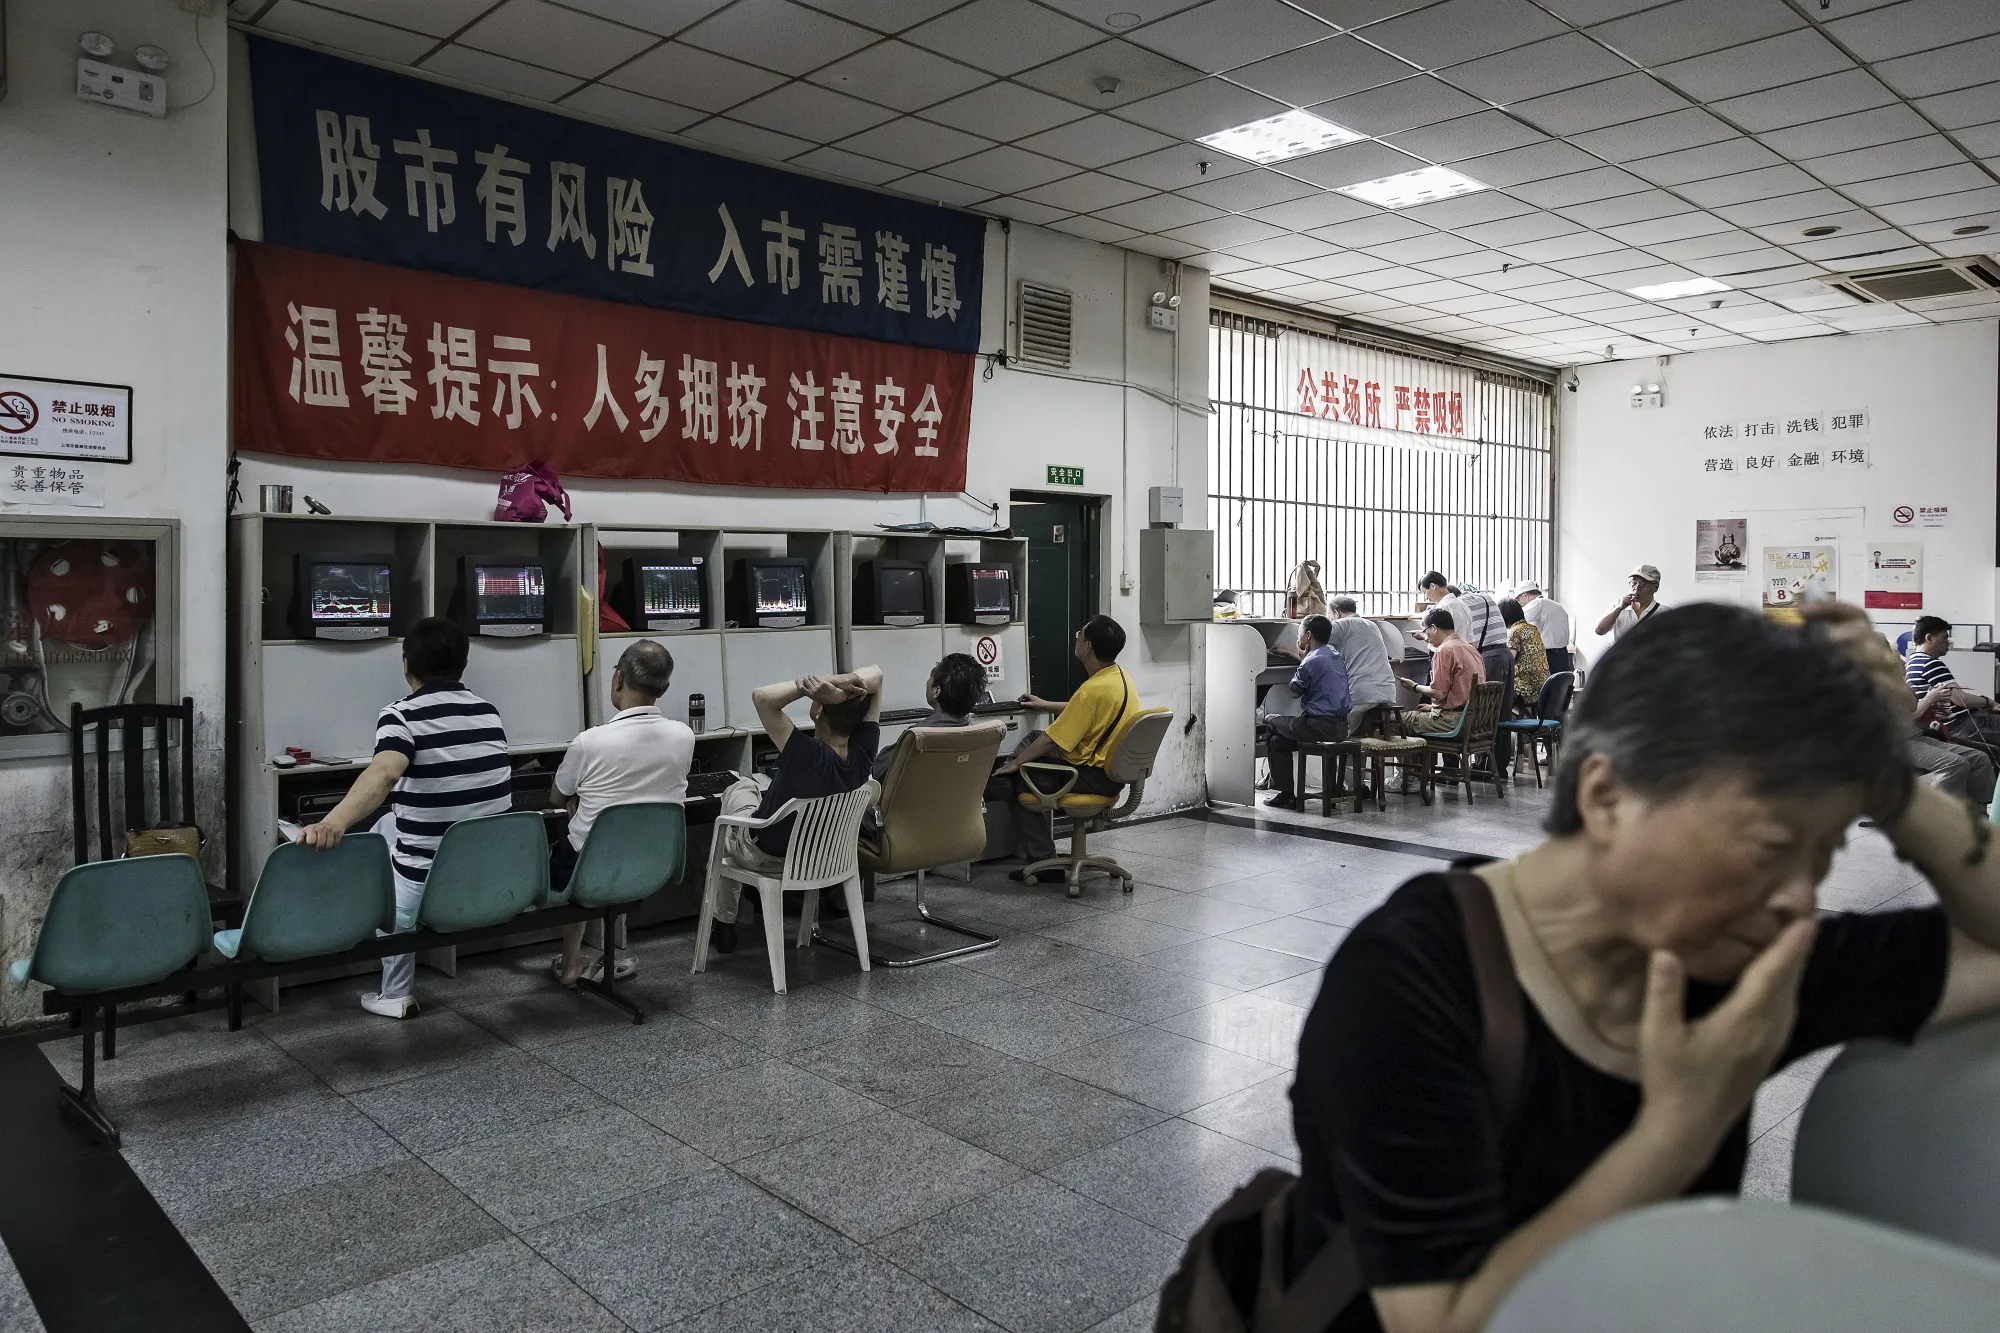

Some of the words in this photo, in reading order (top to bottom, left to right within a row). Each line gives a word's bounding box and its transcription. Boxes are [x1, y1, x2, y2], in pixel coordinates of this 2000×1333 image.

[315, 108, 655, 278] 股市有风险
[707, 201, 962, 323] 入市需谨慎
[52, 400, 116, 418] 禁止吸烟
[583, 343, 767, 451] 人多拥挤
[787, 370, 943, 458] 注意安全
[1297, 367, 1382, 429] 公共场所
[1394, 385, 1465, 436] 严禁吸烟
[70, 418, 115, 428] SMOKING
[1704, 425, 1733, 440] 依法
[1744, 422, 1775, 437] 打击
[1786, 417, 1819, 434] 洗钱
[1831, 413, 1864, 430] 犯罪
[1704, 457, 1734, 472] 营造
[1746, 455, 1775, 470] 良好
[1787, 452, 1820, 467] 金融
[1831, 448, 1865, 464] 环境
[10, 464, 84, 480] 贵重物品
[1050, 467, 1081, 478] 安全出口
[1054, 476, 1077, 485] EXIT
[10, 480, 84, 495] 妥善保管
[1919, 506, 1948, 514] 禁止吸烟
